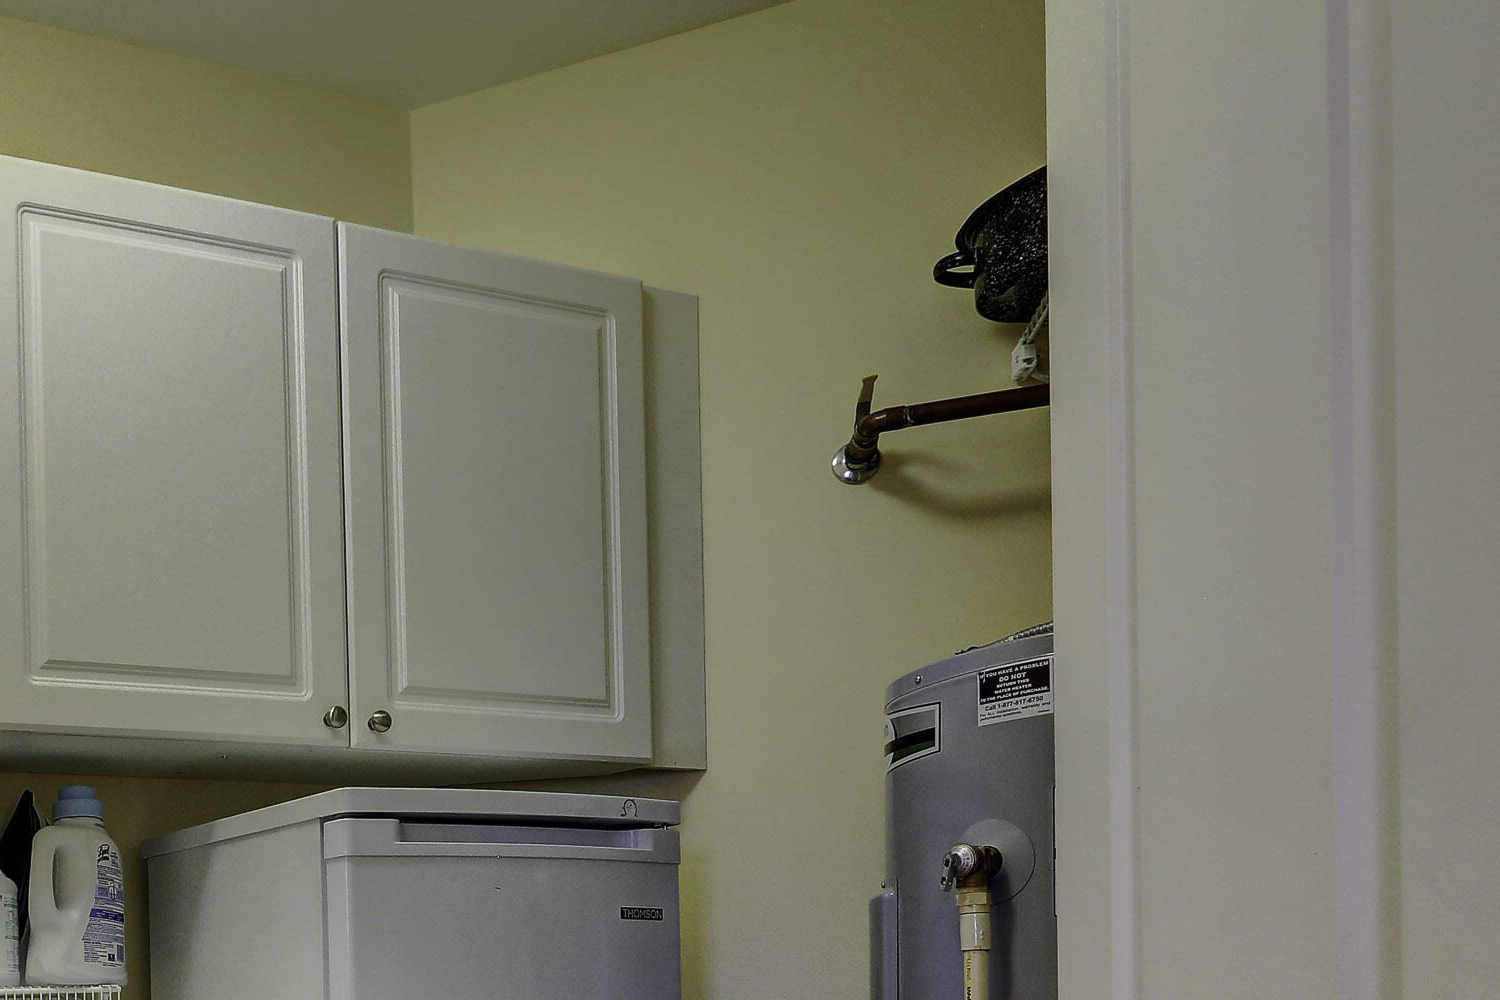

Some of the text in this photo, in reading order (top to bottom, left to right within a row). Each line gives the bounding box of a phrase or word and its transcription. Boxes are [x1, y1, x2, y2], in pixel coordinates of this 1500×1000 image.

[1020, 661, 1049, 670] PROBLEM
[1010, 671, 1027, 679] NOT
[1011, 683, 1032, 691] HEATER
[622, 909, 662, 919] THOMSON
